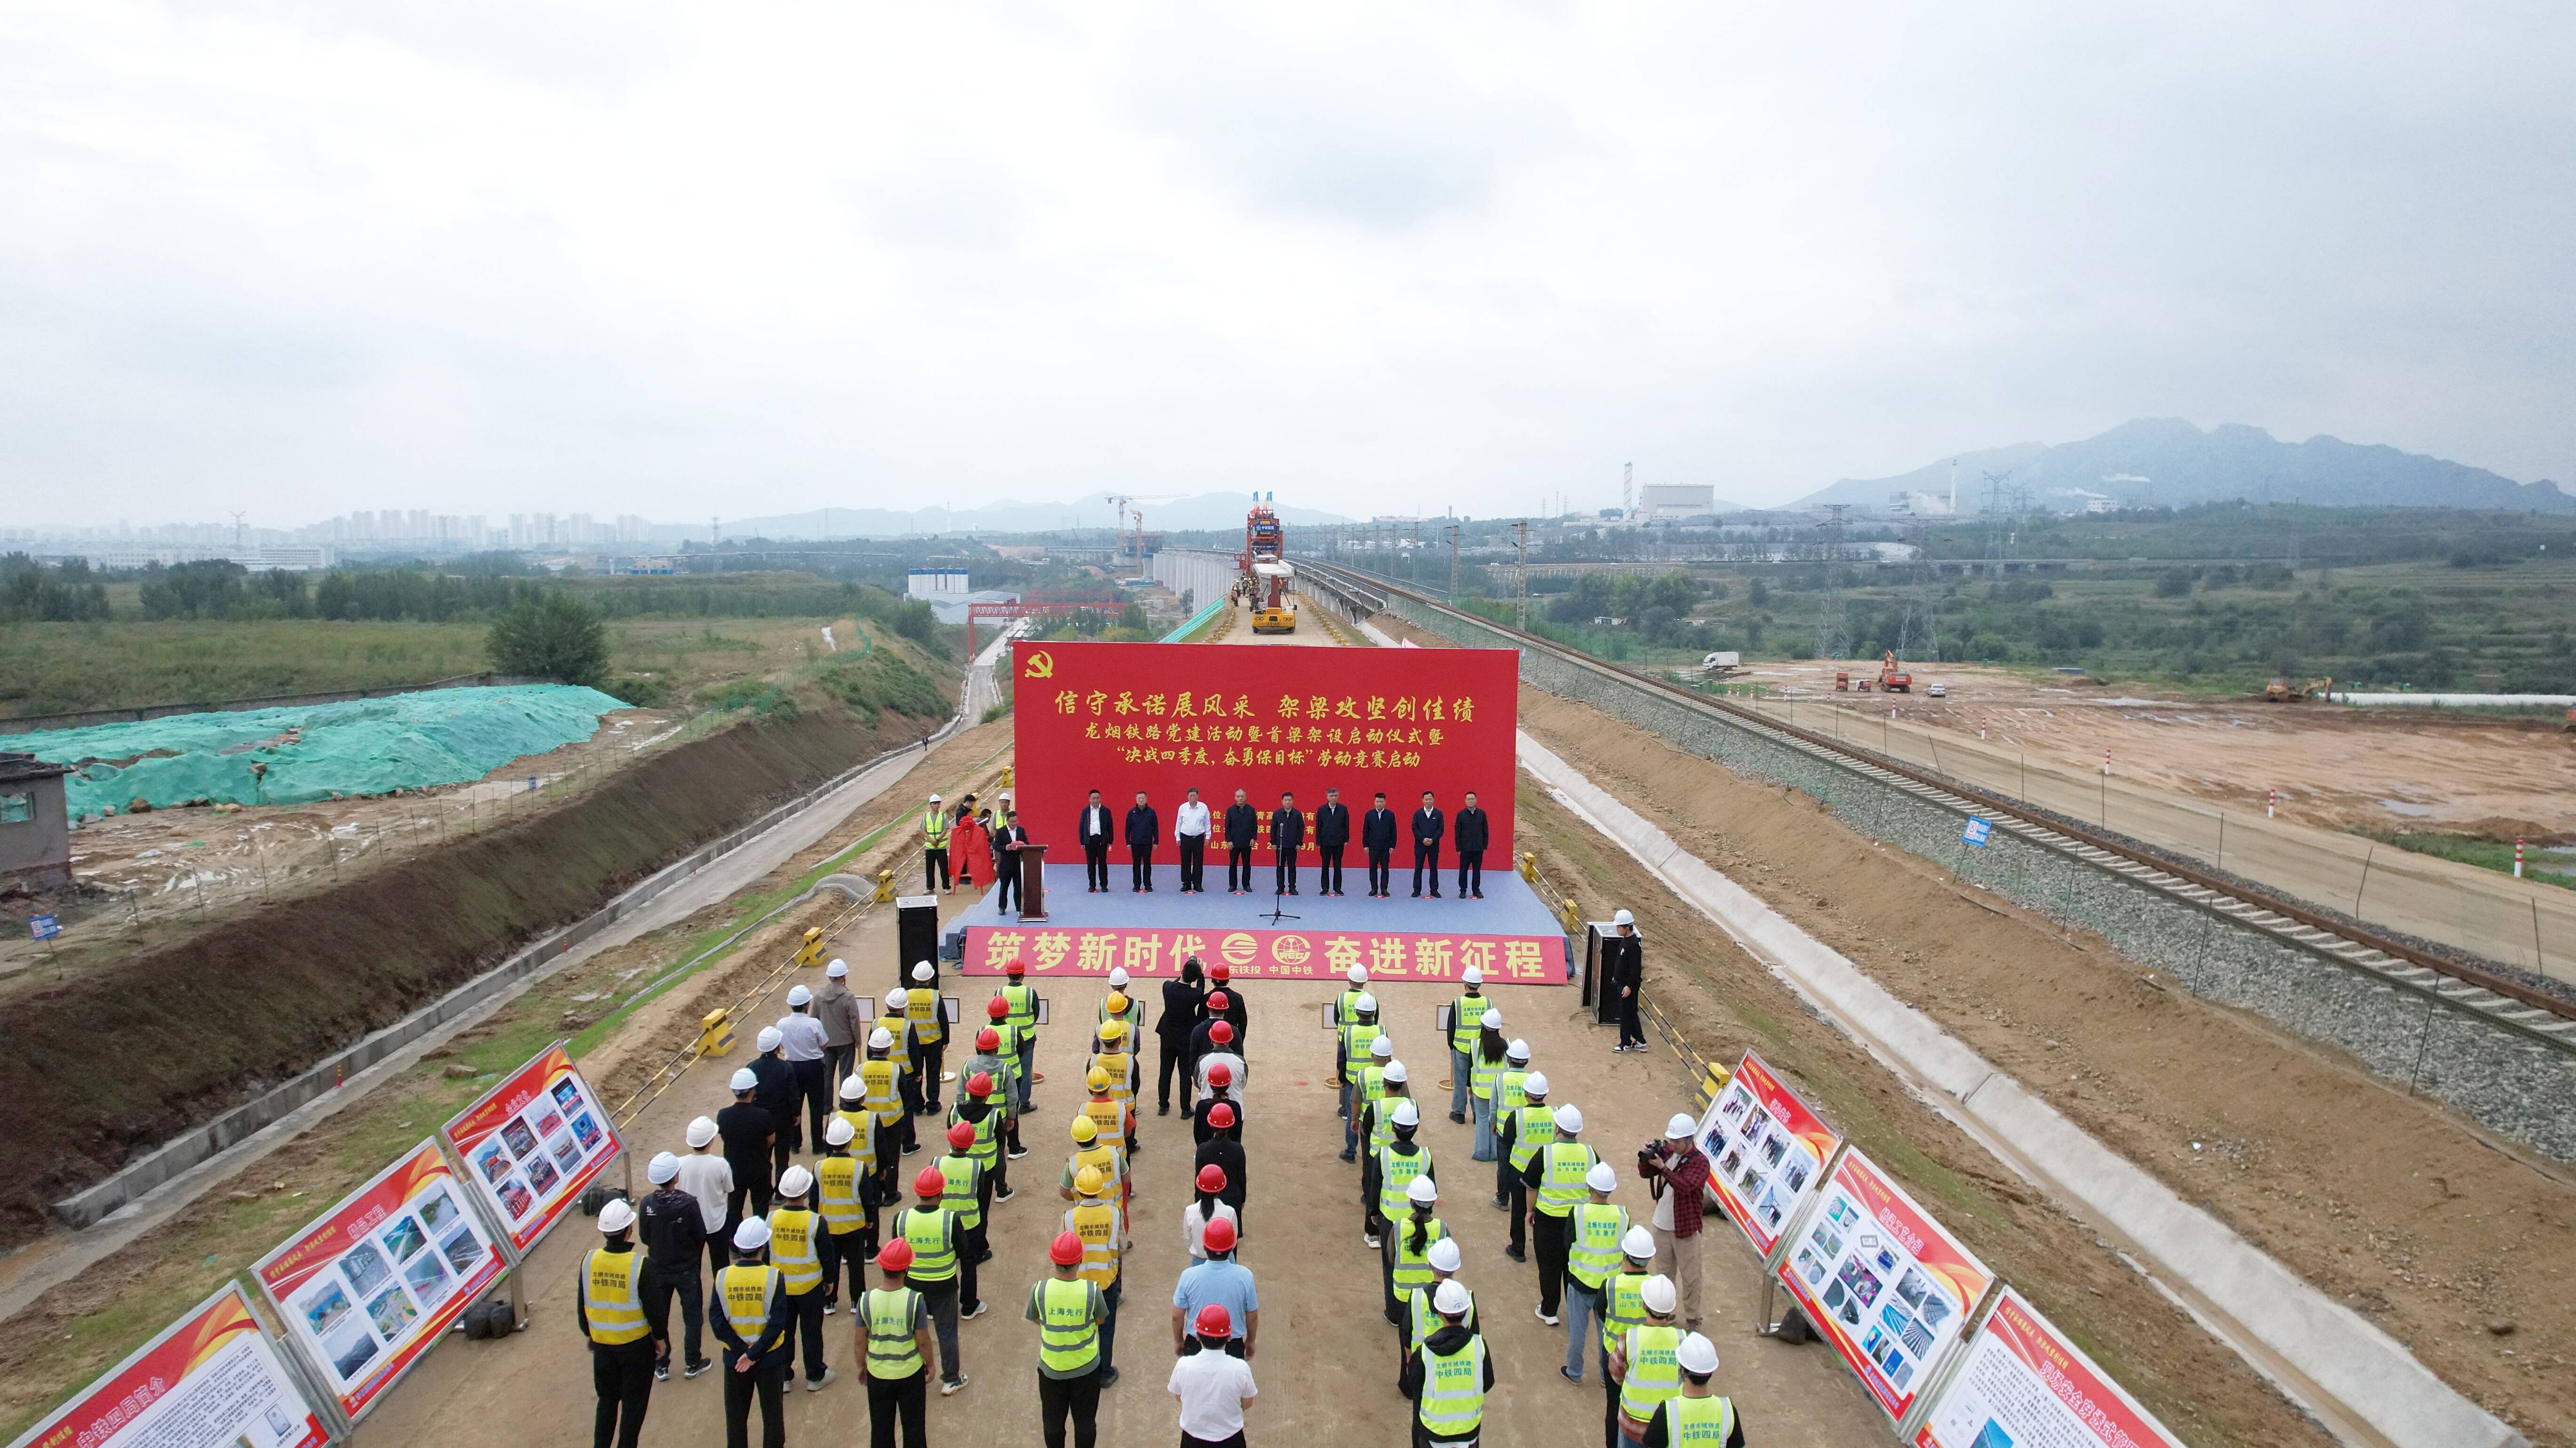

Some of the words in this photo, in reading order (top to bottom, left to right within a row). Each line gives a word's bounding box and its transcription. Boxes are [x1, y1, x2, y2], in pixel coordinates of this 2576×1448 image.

[1055, 690, 1256, 718] 信守承诺展风采
[1277, 694, 1475, 723] 架梁攻坚创佳绩
[1085, 722, 1444, 746] 龙烟铁路党建活动暨首梁架设启动仪式暨
[985, 931, 1206, 972] 筑梦新时代
[1323, 936, 1546, 978] 奋进新征程
[1228, 965, 1261, 974] 东铁投
[1269, 965, 1313, 975] 中国中铁
[346, 1204, 387, 1241] 精品工程
[1878, 1207, 1924, 1256] 桥梁工艺介绍
[775, 1234, 806, 1242] 中铁四局
[592, 1279, 626, 1289] 中铁四局
[728, 1293, 763, 1302] 中铁四局
[1049, 1309, 1083, 1317] 上海先行
[874, 1318, 903, 1326] 上海先行
[1641, 1356, 1677, 1365] 中铁四局
[1436, 1368, 1471, 1378] 中铁四局
[77, 1376, 166, 1448] 中铁四局简介
[1683, 1431, 1720, 1440] 中铁四局
